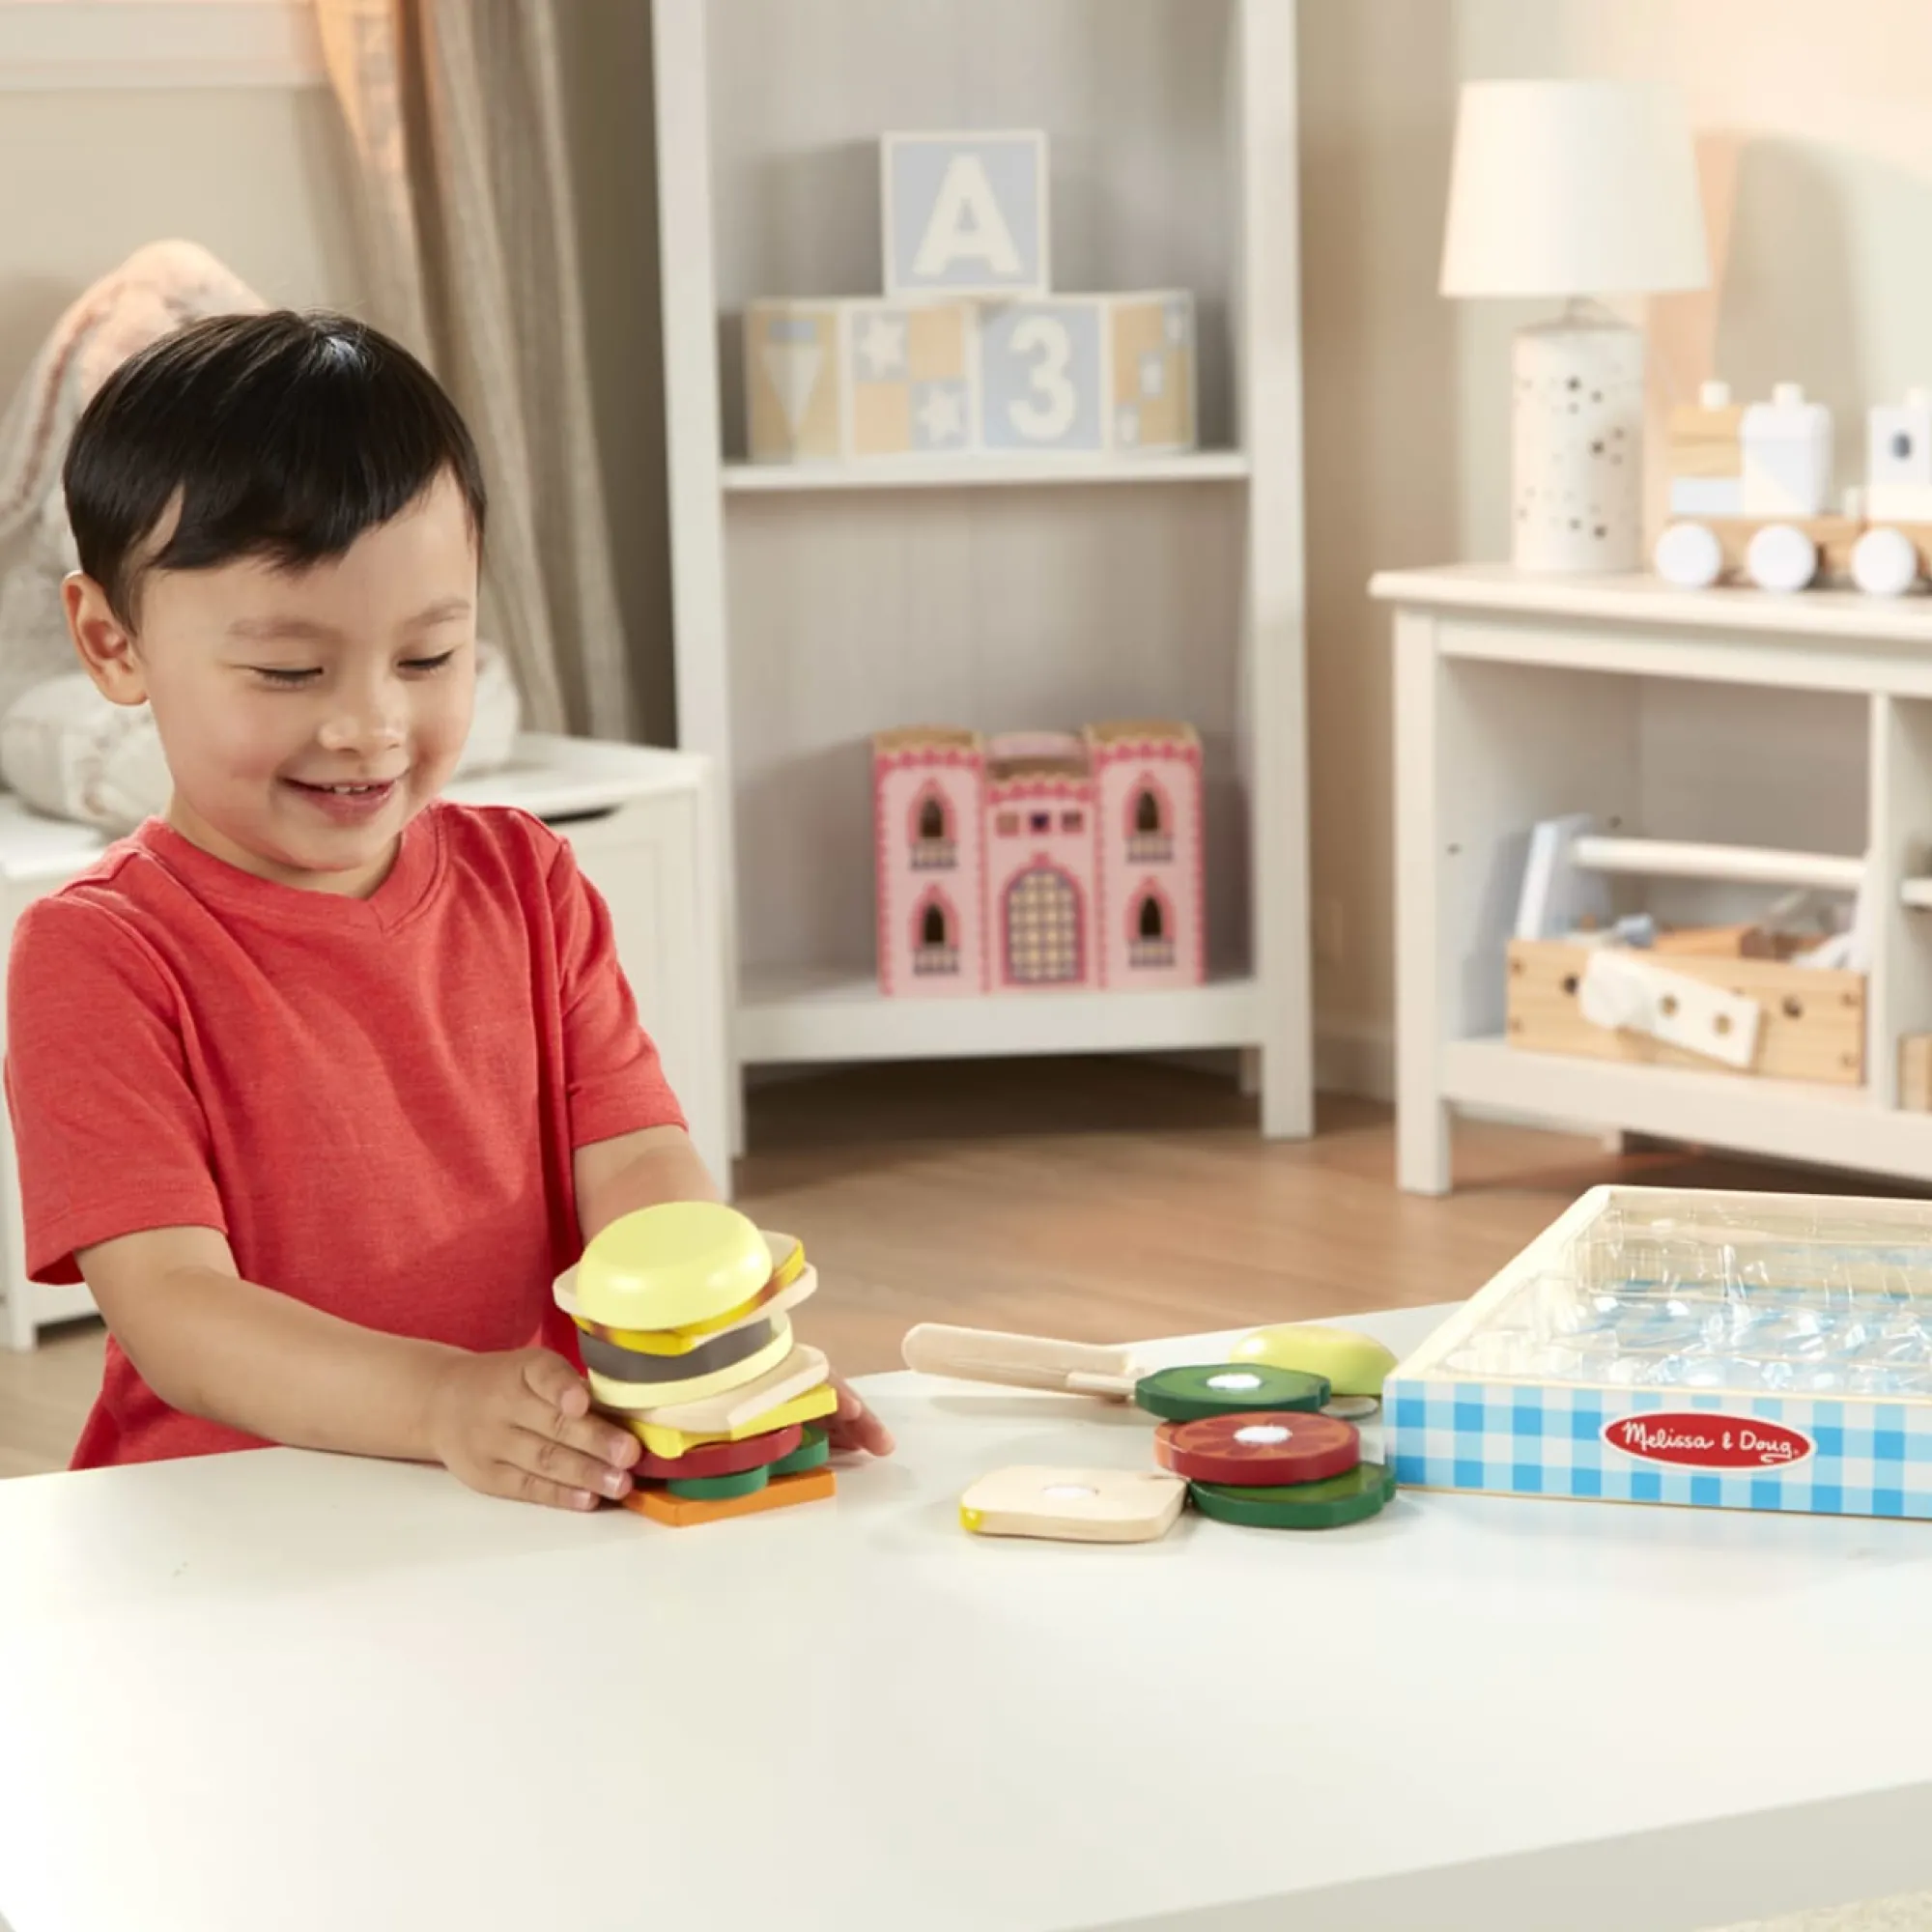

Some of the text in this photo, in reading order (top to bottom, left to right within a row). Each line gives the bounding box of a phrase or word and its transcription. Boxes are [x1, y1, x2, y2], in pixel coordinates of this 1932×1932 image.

[912, 153, 1024, 276] A
[1007, 314, 1076, 440] 3
[1622, 1420, 1793, 1463] Melissa & Doug
